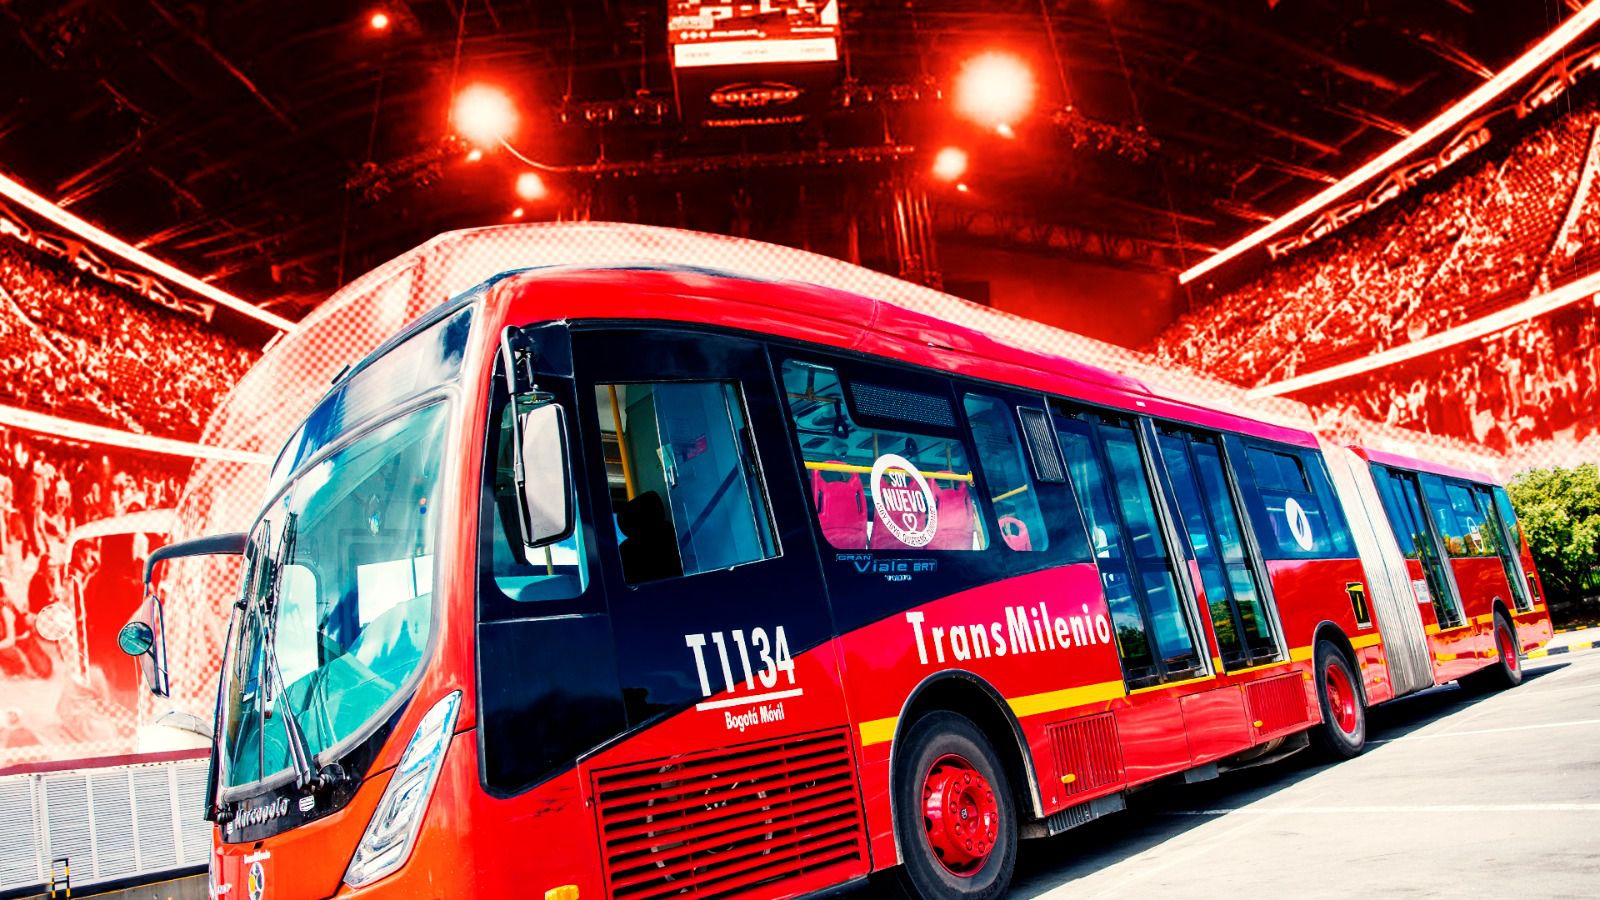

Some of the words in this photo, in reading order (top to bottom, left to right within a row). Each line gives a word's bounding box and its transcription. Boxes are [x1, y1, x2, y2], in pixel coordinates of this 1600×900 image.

[888, 471, 907, 488] SOY
[882, 488, 927, 513] NUEVO
[853, 560, 908, 573] Viale
[913, 562, 936, 572] BRT
[905, 601, 1111, 665] TransMilenio
[685, 625, 796, 697] T1134
[724, 706, 759, 732] Bogotá
[759, 701, 785, 724] Móvil
